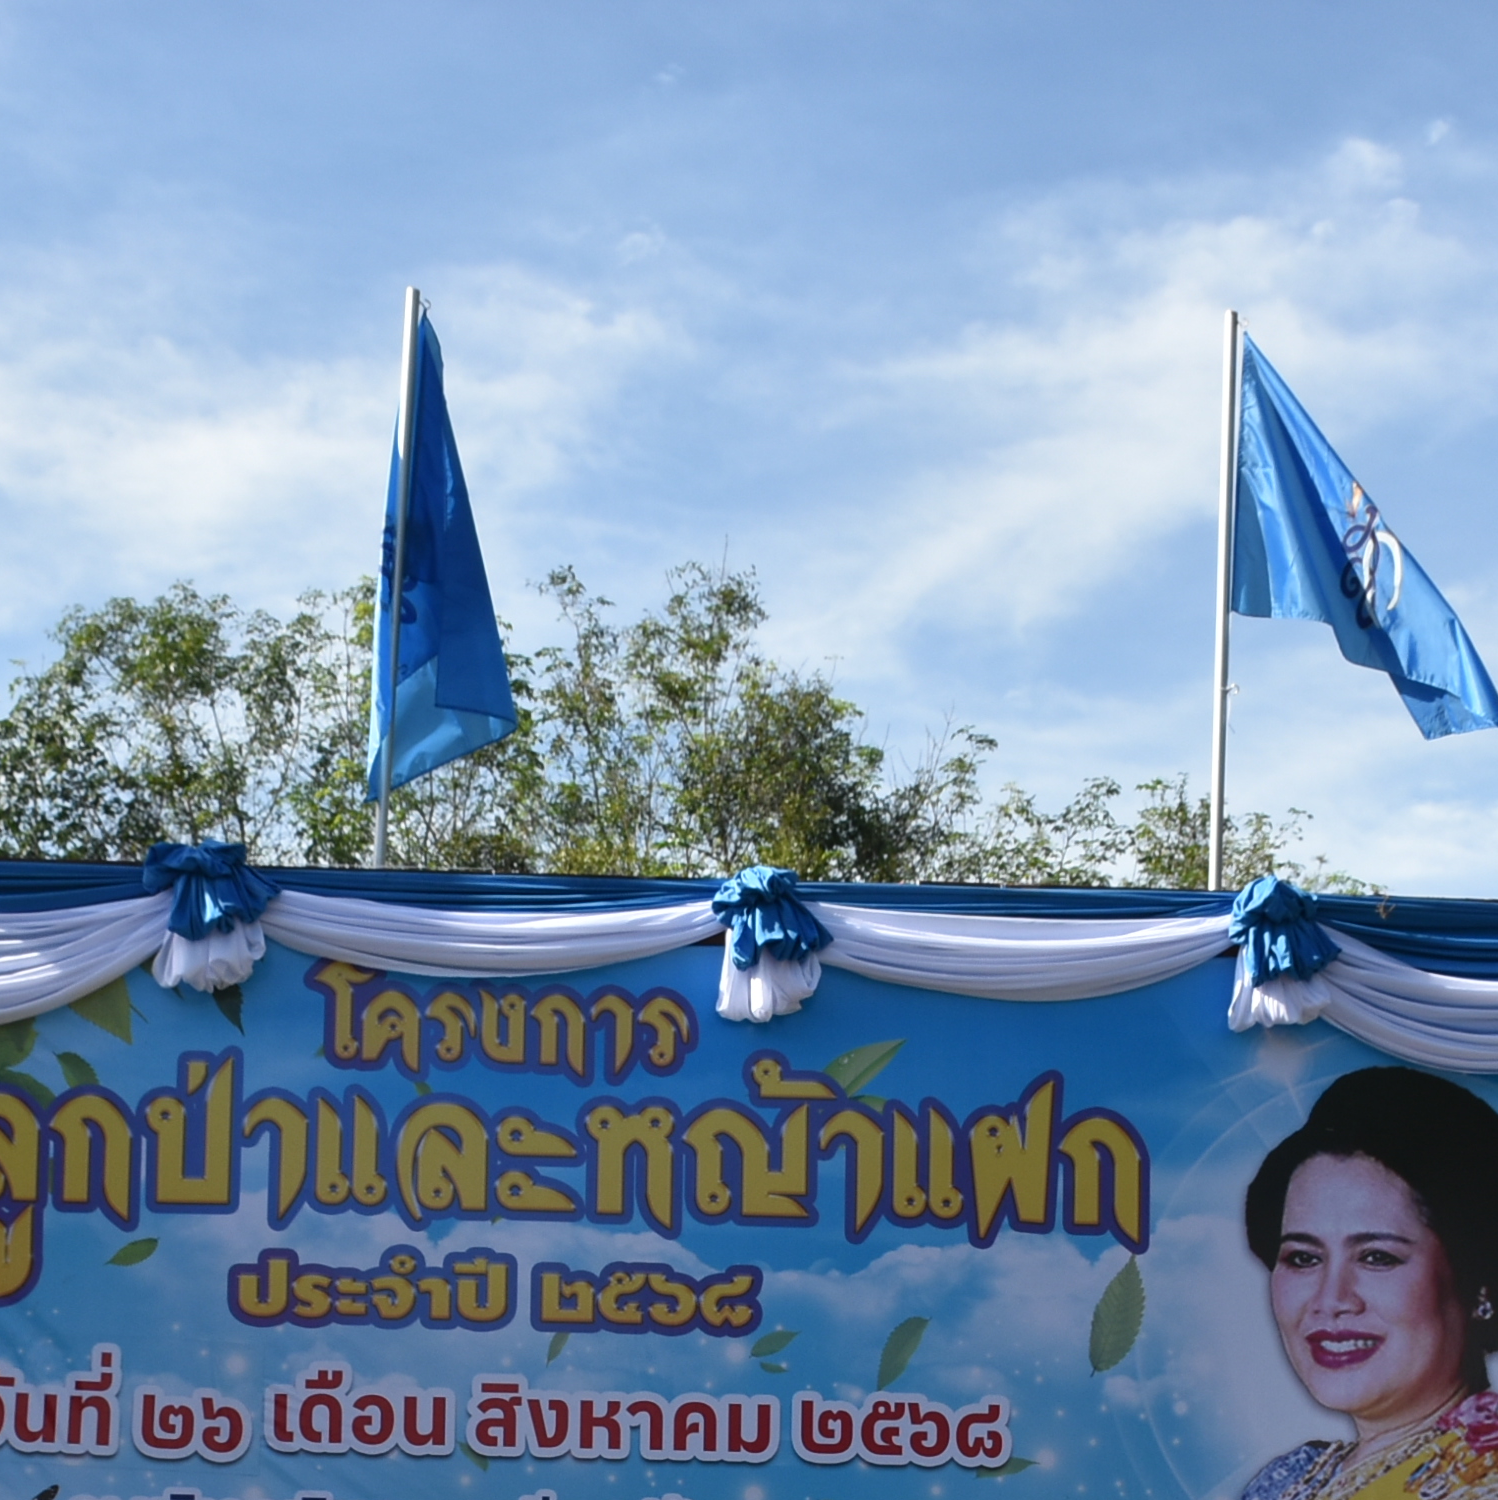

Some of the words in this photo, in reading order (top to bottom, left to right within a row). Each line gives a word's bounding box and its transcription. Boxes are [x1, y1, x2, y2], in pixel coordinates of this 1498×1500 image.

[311, 960, 691, 1078] โครงการ
[237, 1254, 509, 1322] ประจำปี
[540, 1270, 755, 1328] ๒๕๖๘
[140, 1392, 245, 1454] ๒๖
[272, 1369, 448, 1447] เดือน
[474, 1382, 772, 1454] สิงหาคม
[800, 1399, 1003, 1459] ๒๕๖๘
